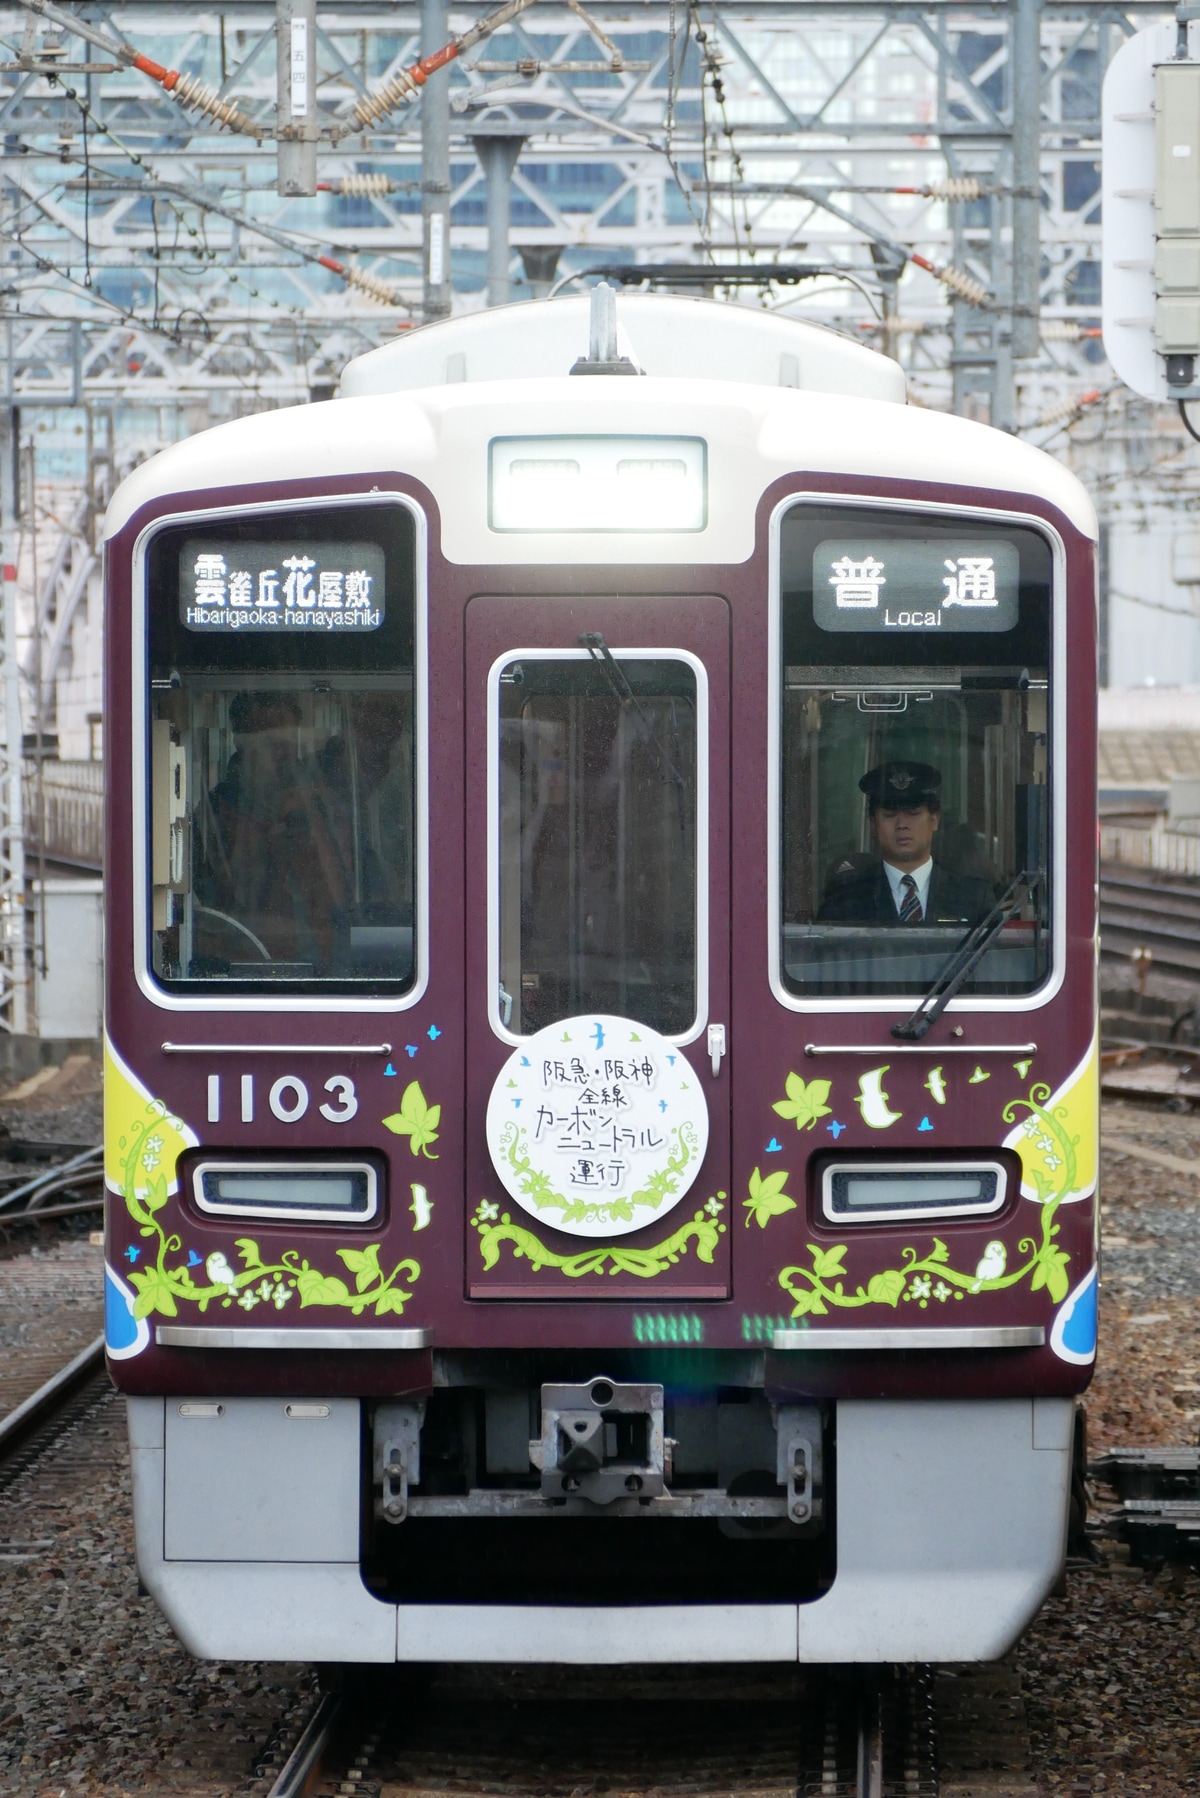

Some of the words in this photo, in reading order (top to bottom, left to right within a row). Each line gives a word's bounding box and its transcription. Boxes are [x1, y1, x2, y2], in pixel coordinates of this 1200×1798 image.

[194, 554, 373, 607] 雲雀丘花屋敷
[828, 556, 999, 608] 普通
[186, 607, 380, 629] Hibarigaoka-hanayashiki
[884, 608, 942, 626] Local
[543, 1055, 653, 1085] 阪急・阪神
[207, 1075, 358, 1123] 1103
[578, 1084, 627, 1108] 全線
[535, 1105, 613, 1138] カーボン
[557, 1125, 663, 1153] ニュートラル
[569, 1159, 626, 1187] 運行
